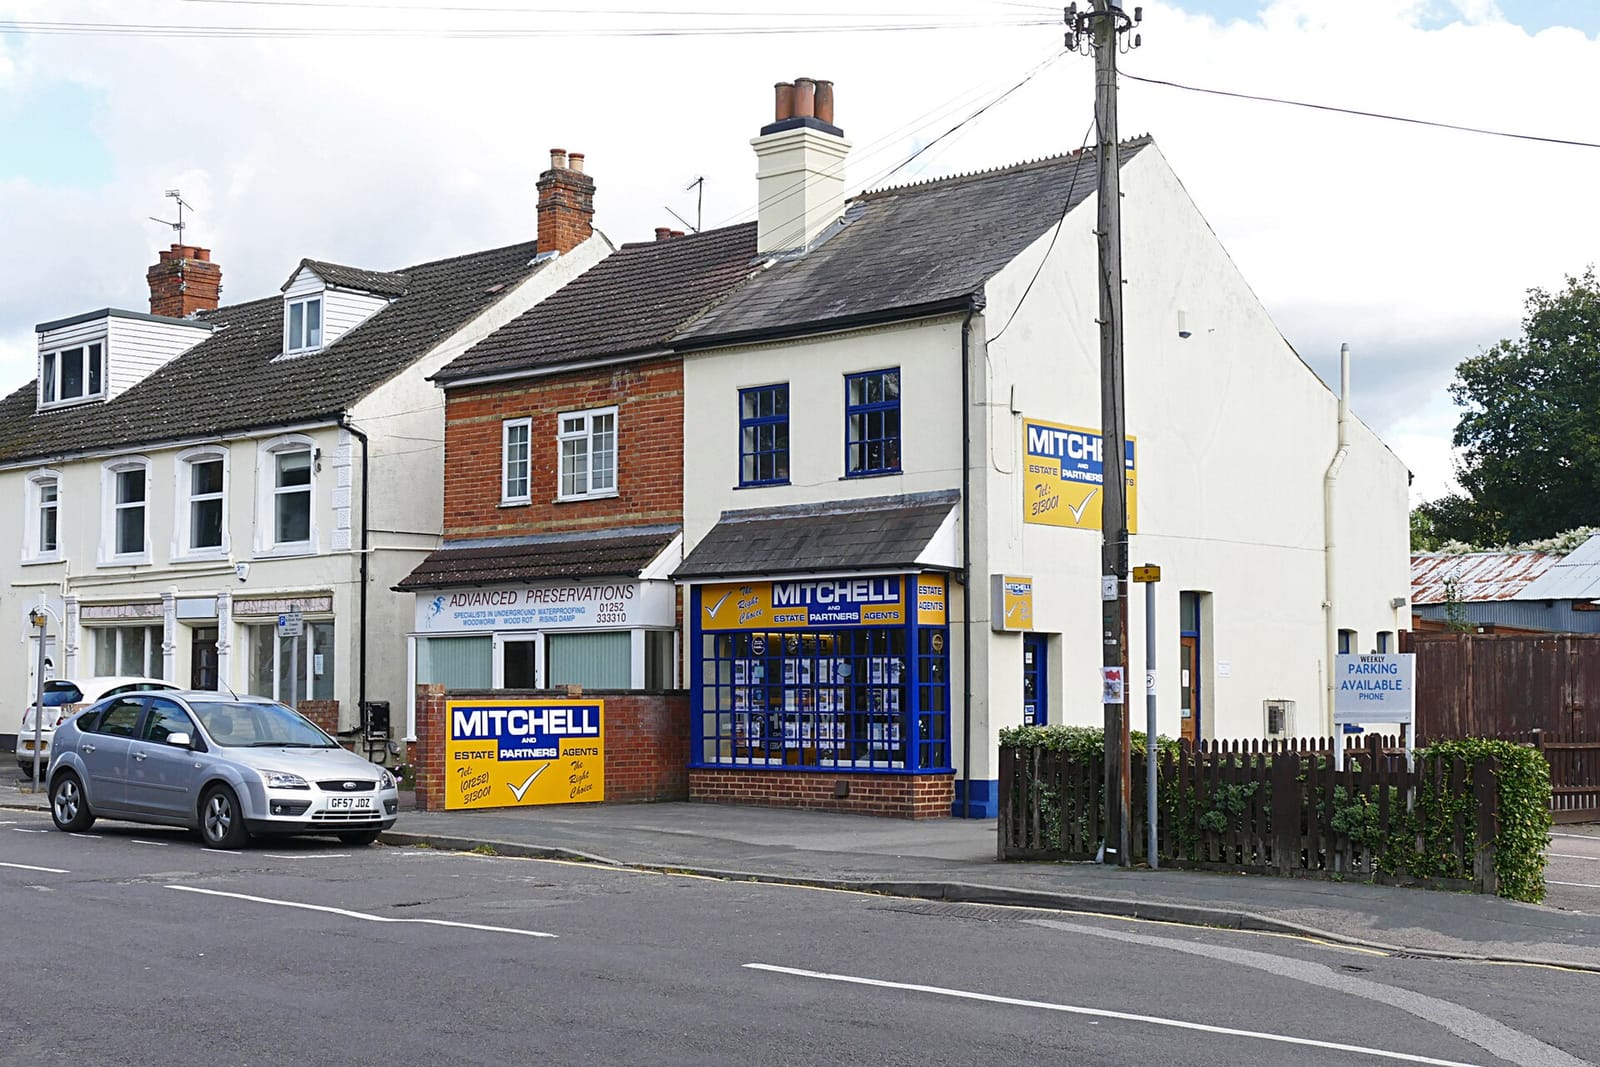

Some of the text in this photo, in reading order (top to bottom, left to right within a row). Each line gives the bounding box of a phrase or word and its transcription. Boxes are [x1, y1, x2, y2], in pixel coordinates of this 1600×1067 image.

[1028, 427, 1134, 468] MITCH
[1029, 464, 1104, 483] ESTATE PARTNERS
[1035, 483, 1051, 498] Tel:
[1031, 495, 1059, 516] 313001
[449, 584, 635, 607] ADVANCED PRESERVATIONS
[739, 585, 753, 596] The
[773, 579, 898, 605] MITCHELL
[918, 586, 942, 595] ESTATE
[599, 602, 624, 613] 01252
[737, 596, 759, 609] Right
[918, 601, 943, 611] AGENTS
[454, 606, 585, 619] SPECIALISTS IN UNDERGROUND WATERPROOFING
[596, 612, 627, 623] 333310
[739, 608, 763, 624] Choice
[774, 611, 899, 623] ESTATE PARTNERS AGENTS
[463, 618, 496, 626] WOODWORM
[521, 616, 533, 624] ROT
[539, 615, 558, 623] RISING
[559, 614, 576, 623] DAMP
[1360, 655, 1385, 663] WEEKLY
[1348, 663, 1398, 674] PARKING
[1340, 679, 1403, 691] AVAILABLE
[1358, 692, 1385, 701] PHONE
[453, 709, 598, 737] MITCHELL
[454, 747, 598, 760] ESTATE PARTNERS AGENTS
[457, 765, 473, 778] Tel:
[570, 760, 583, 771] The
[460, 771, 490, 793] (01252)
[568, 770, 590, 785] Right
[463, 785, 492, 805] 313001
[569, 783, 593, 799] Choice
[331, 798, 370, 808] GF57 JDZ
